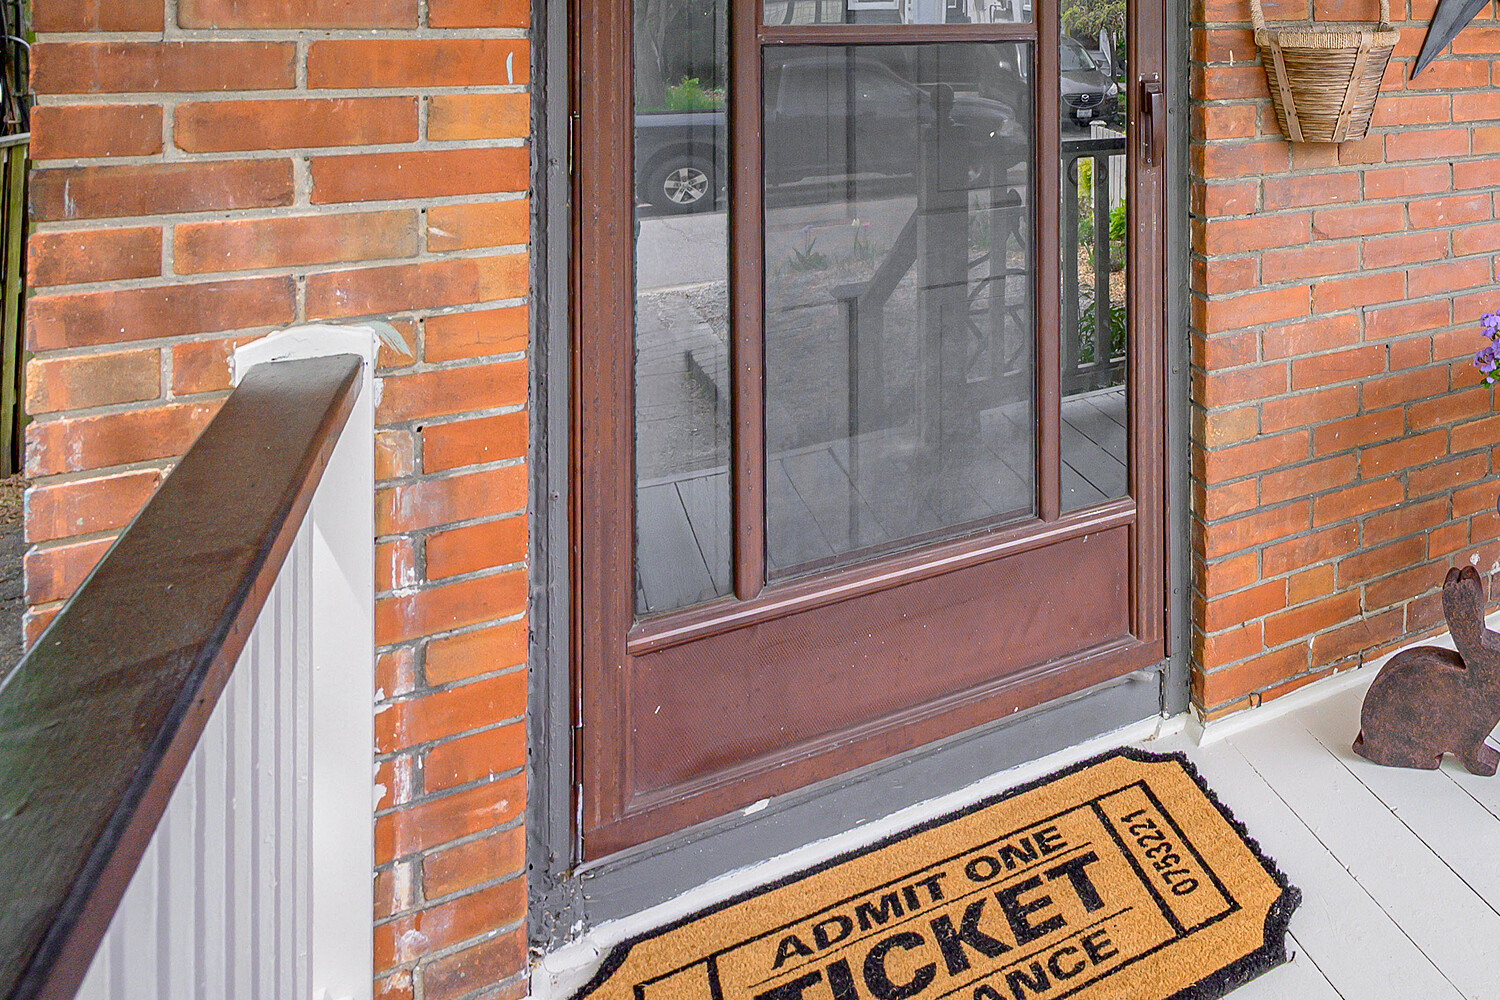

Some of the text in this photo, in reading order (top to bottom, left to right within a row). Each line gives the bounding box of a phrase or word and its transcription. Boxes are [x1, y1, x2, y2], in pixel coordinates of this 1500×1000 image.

[772, 826, 1068, 970] ADMIT ONE
[1121, 809, 1198, 896] 0753221
